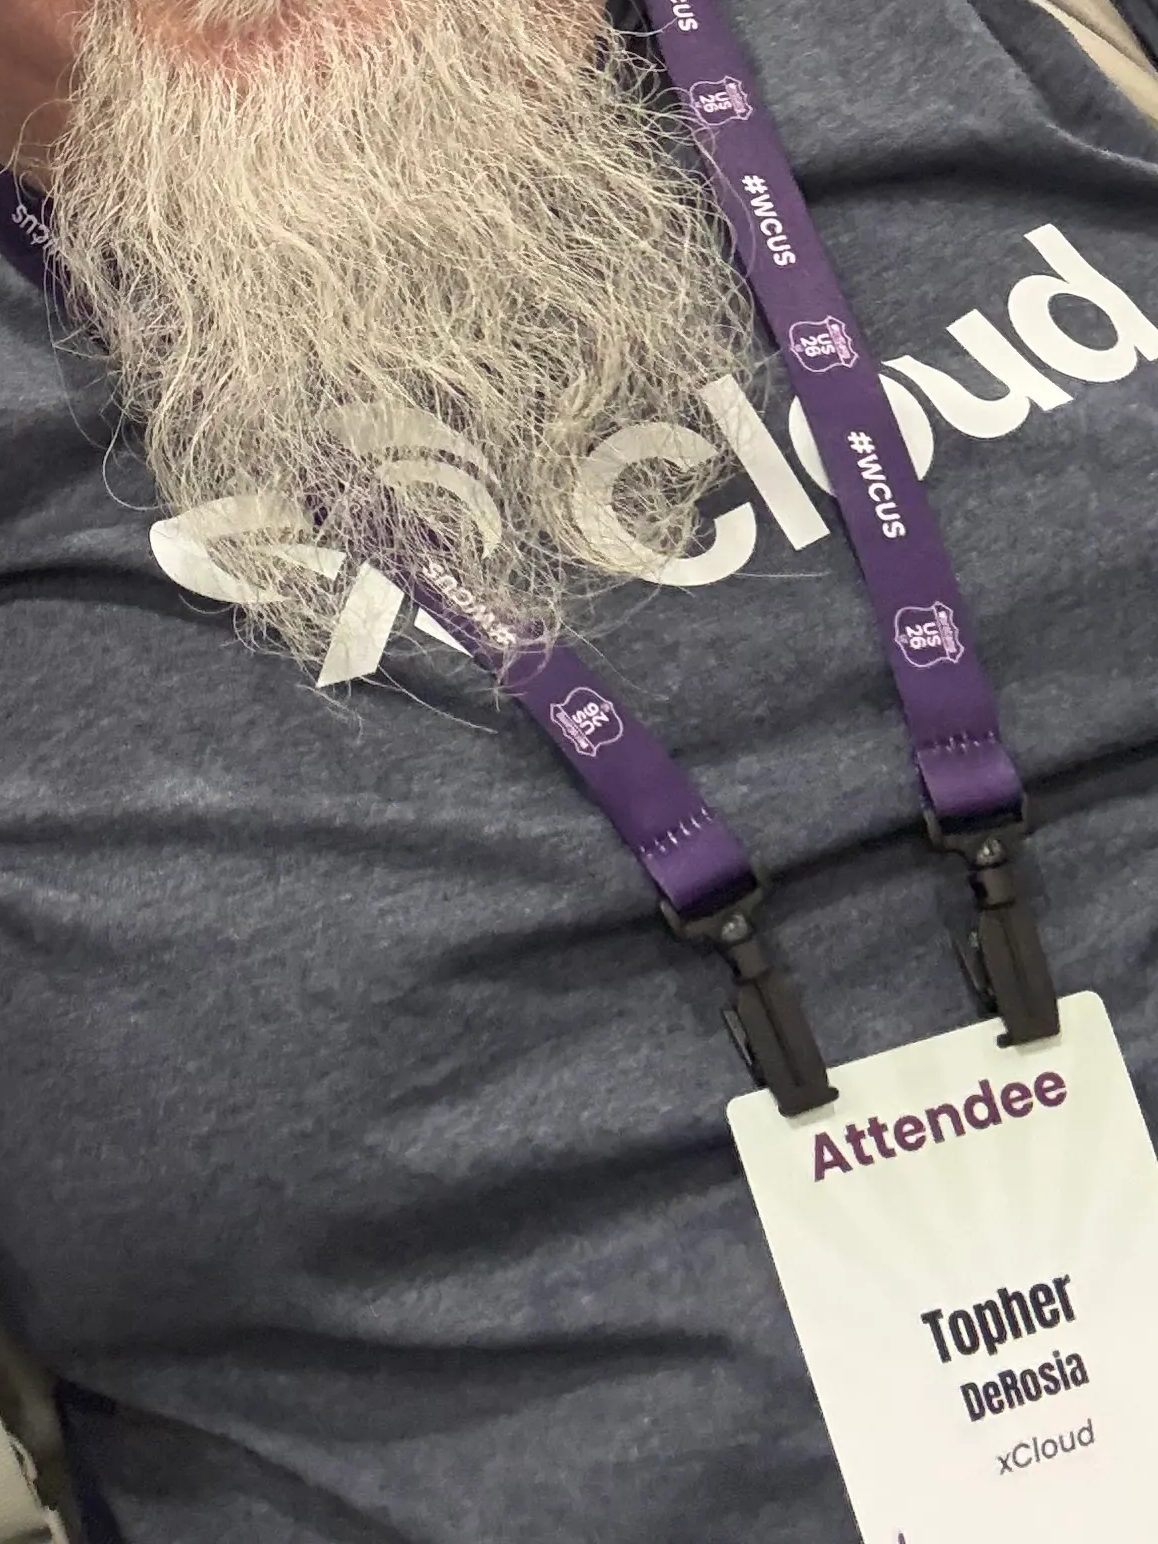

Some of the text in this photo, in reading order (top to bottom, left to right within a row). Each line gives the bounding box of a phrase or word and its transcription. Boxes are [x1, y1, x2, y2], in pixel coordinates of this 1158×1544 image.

[715, 91, 732, 110] US
[741, 175, 797, 267] #WCUS
[816, 333, 836, 356] US
[847, 431, 907, 539] #WCUS
[905, 623, 928, 650] 26
[922, 621, 942, 648] US
[571, 710, 596, 736] US
[583, 701, 610, 728] 26
[814, 1071, 1068, 1183] Attendee
[920, 1274, 1077, 1364] Topher
[960, 1350, 1090, 1422] DeRosia
[997, 1418, 1095, 1475] xCloud
